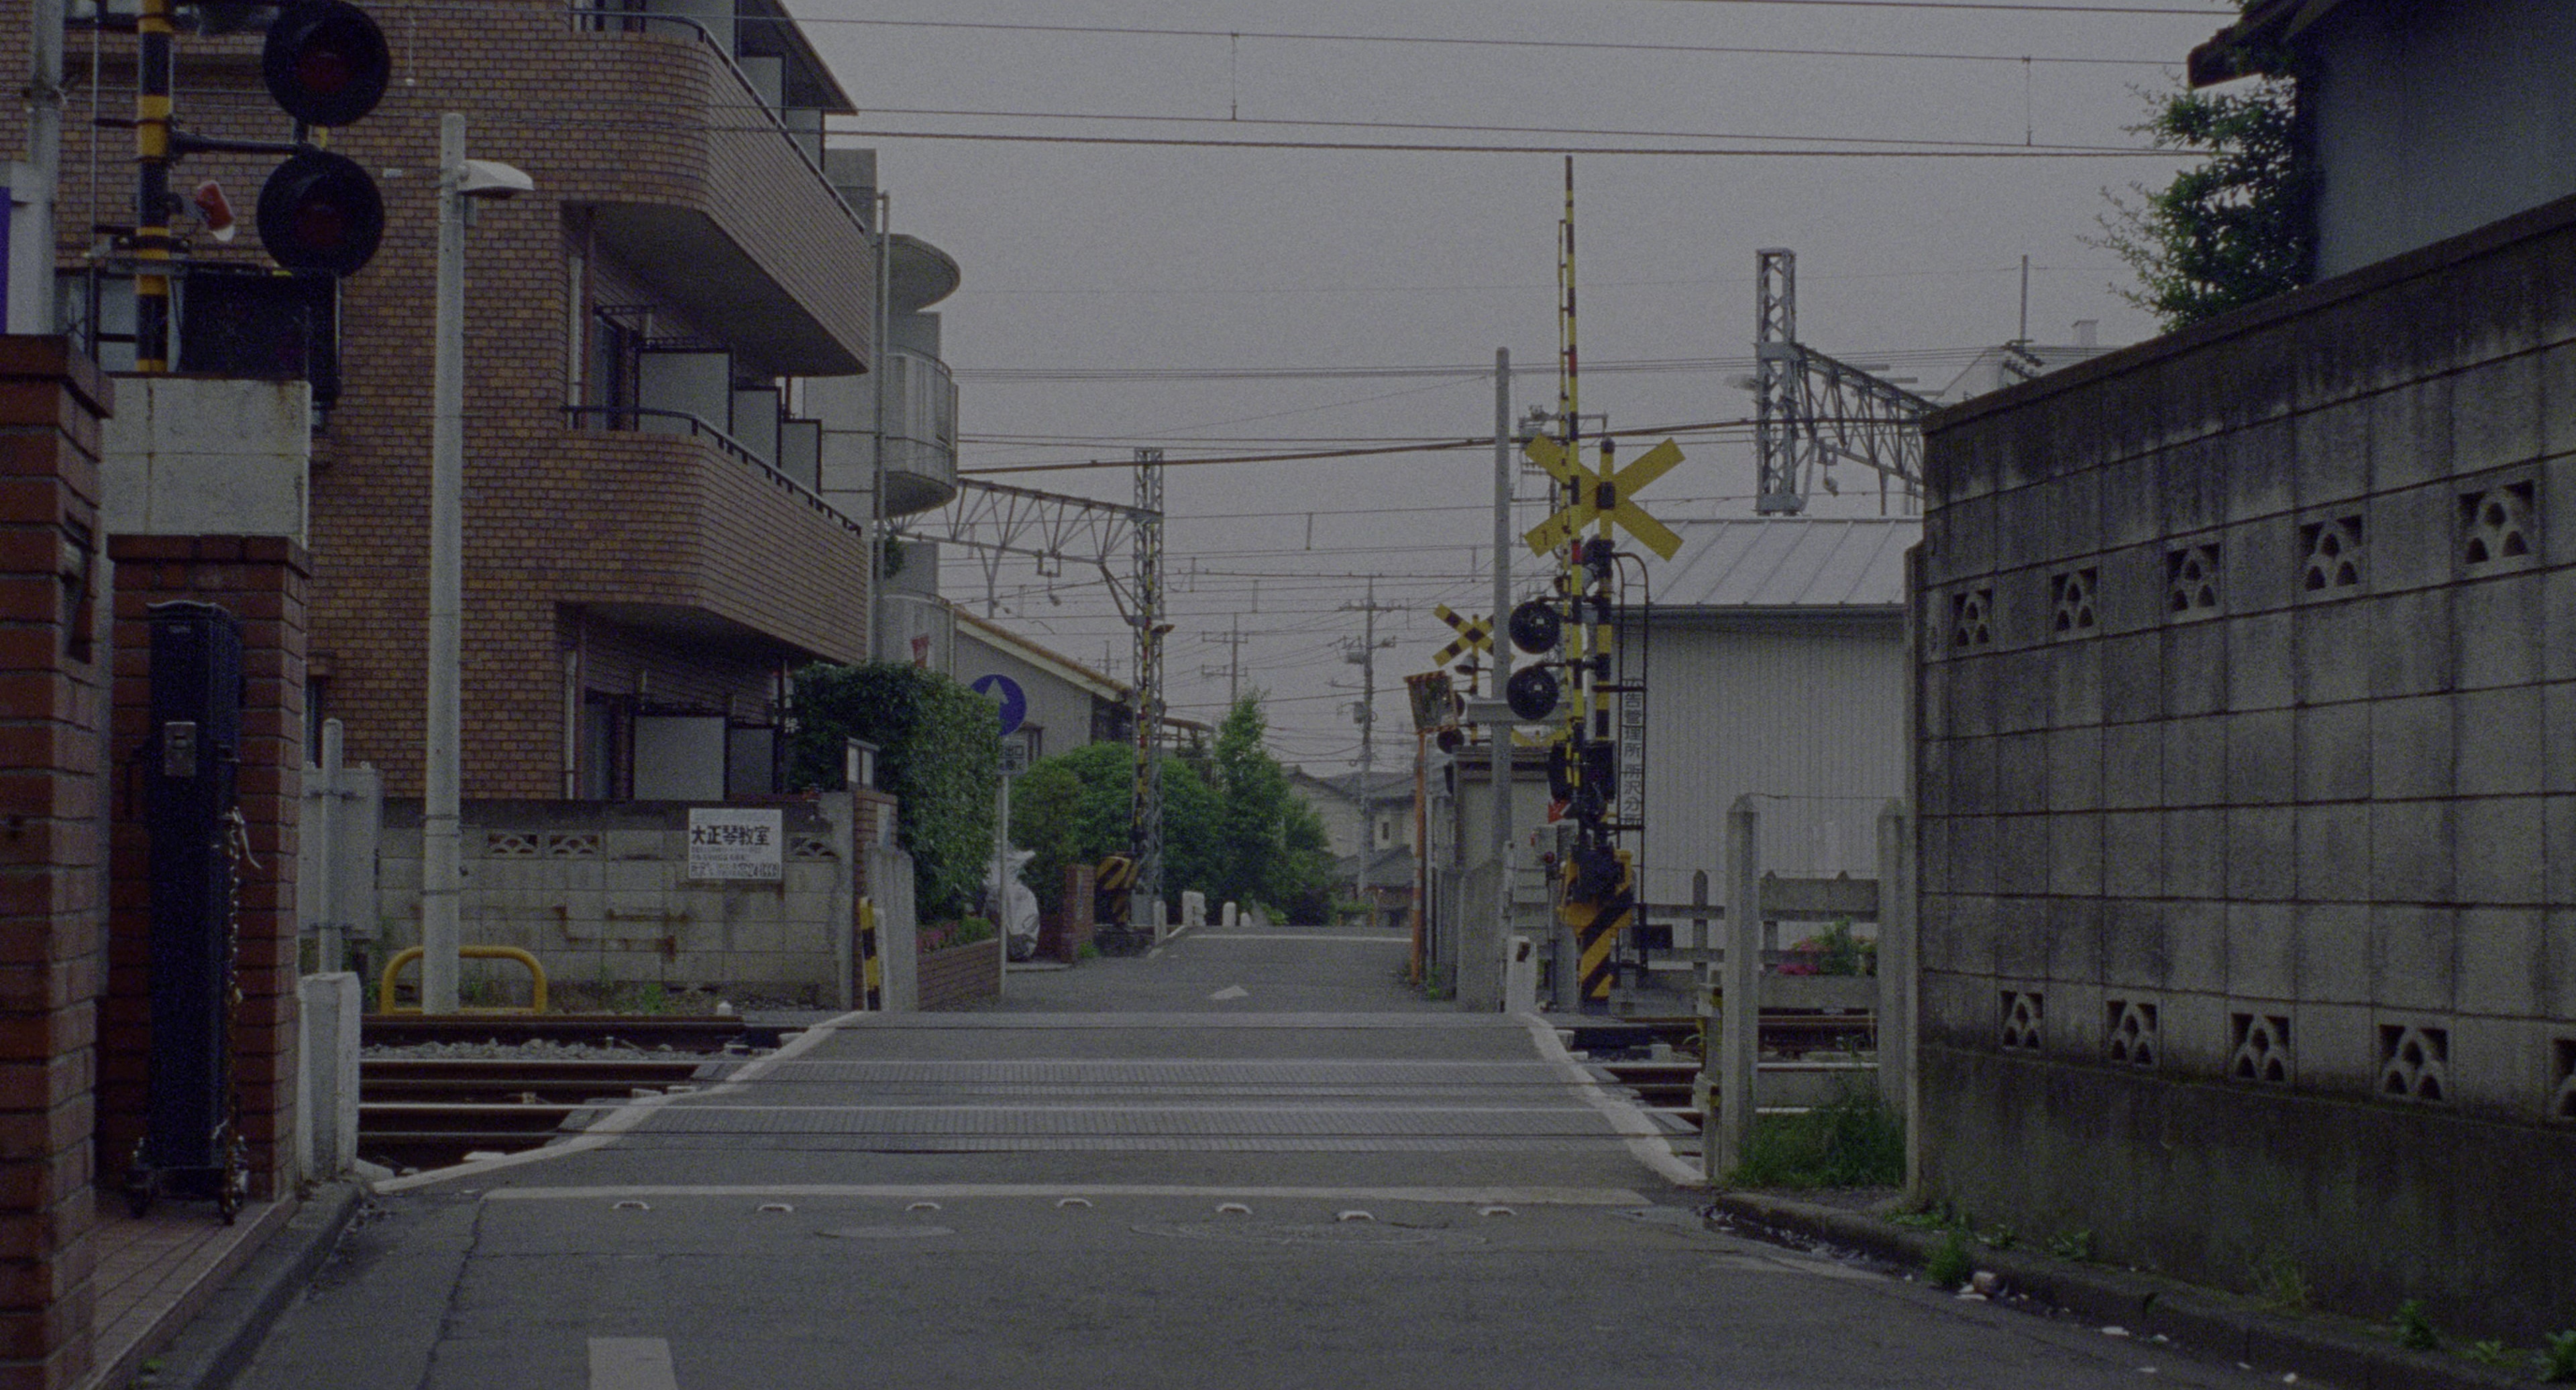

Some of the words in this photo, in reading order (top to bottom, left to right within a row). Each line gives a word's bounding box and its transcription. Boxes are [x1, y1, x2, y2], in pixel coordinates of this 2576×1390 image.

[692, 825, 769, 845] 大正琴教室
